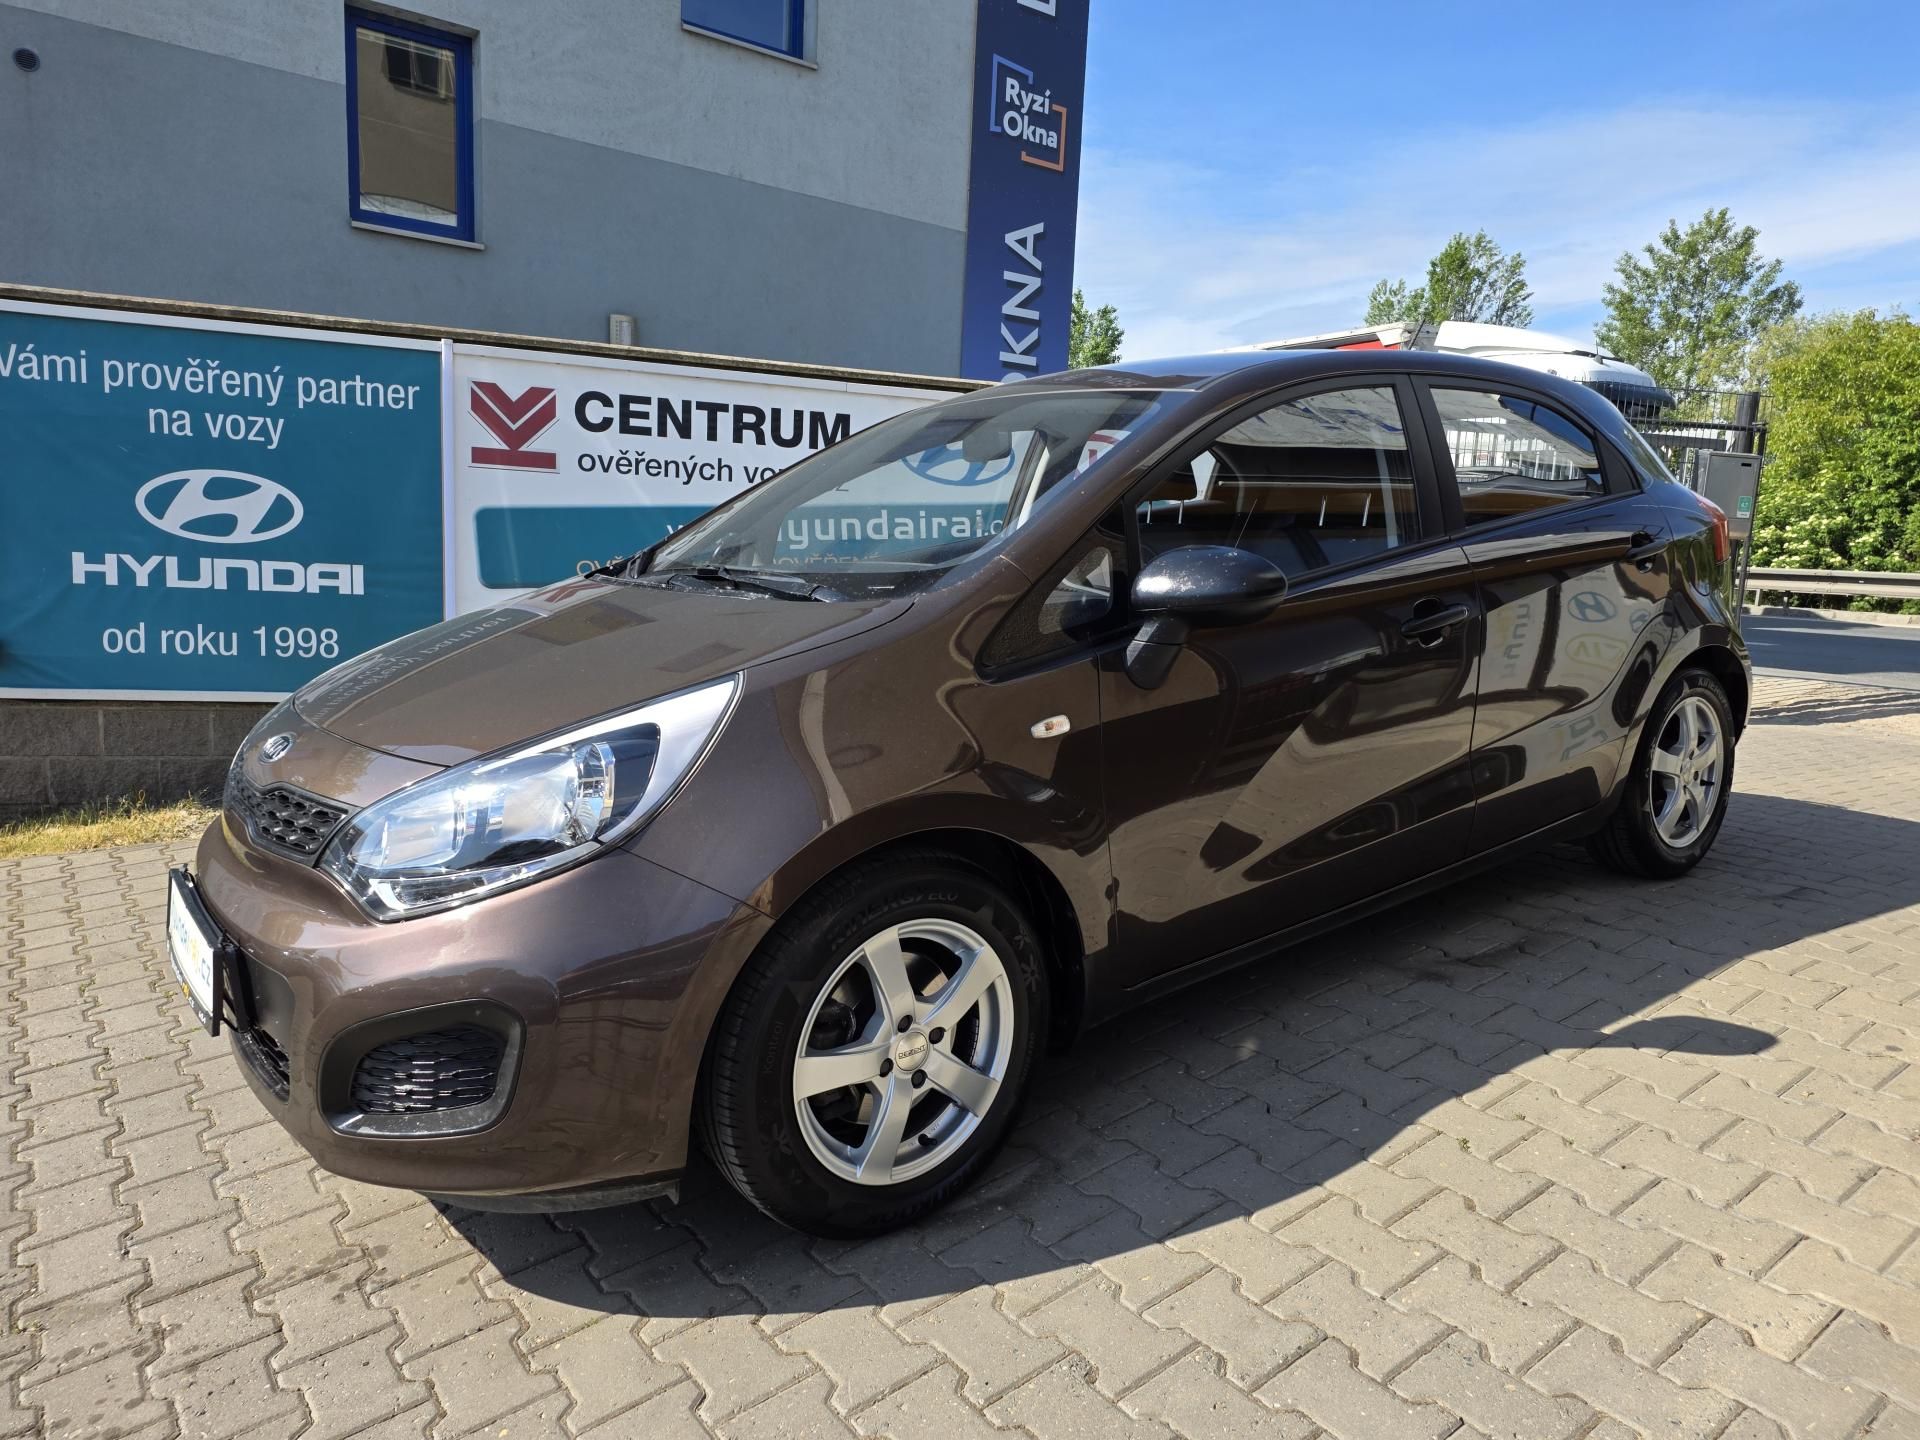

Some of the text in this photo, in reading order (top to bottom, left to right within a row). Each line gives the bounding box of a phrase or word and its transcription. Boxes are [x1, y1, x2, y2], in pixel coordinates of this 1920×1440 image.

[1004, 77, 1051, 115] Ryzí
[1003, 110, 1058, 149] Okna
[999, 222, 1045, 384] KNA
[103, 357, 285, 407] prověřený
[297, 374, 420, 410] partner
[148, 408, 285, 449] na vozy
[574, 390, 851, 450] CENTRUM
[577, 449, 781, 486] ověřených vo
[72, 551, 365, 595] HYUNDAI
[102, 622, 340, 659] od roku 1998
